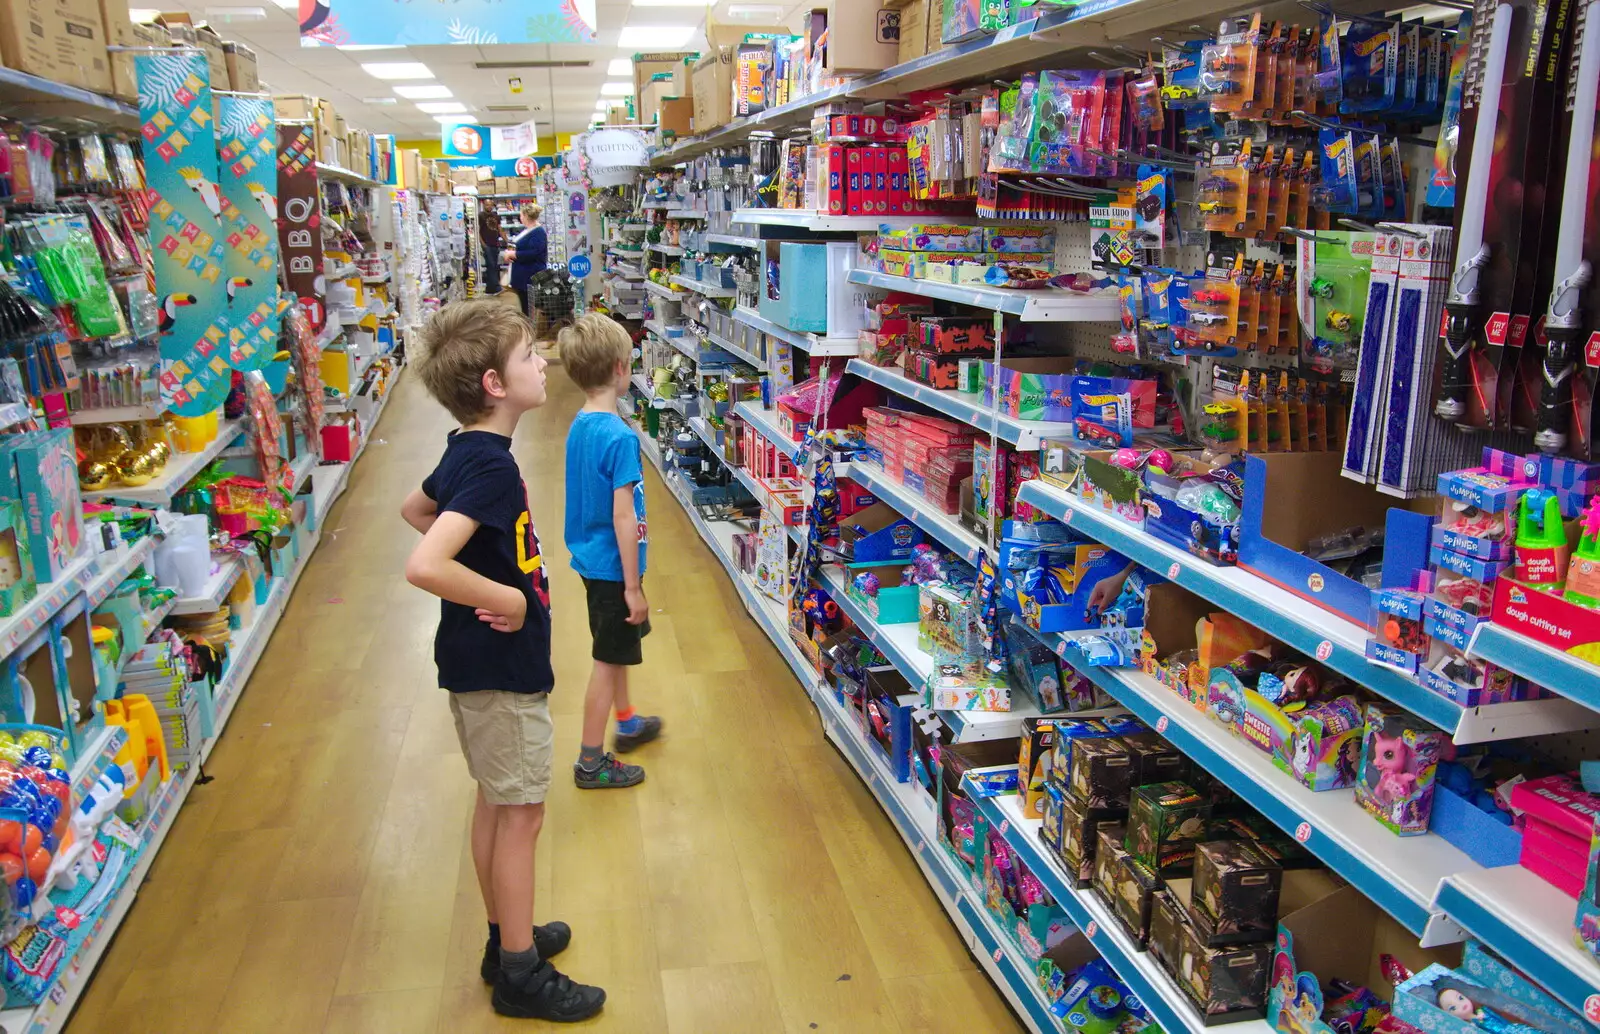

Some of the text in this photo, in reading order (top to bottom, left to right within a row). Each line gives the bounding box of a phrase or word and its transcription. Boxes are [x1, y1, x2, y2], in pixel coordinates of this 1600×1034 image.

[1525, 48, 1537, 77] LIGHT
[1532, 29, 1540, 44] UP
[1546, 52, 1557, 81] LIGHT
[1552, 34, 1560, 48] UP
[591, 143, 639, 153] LIGHTING
[518, 162, 535, 177] £1
[1091, 208, 1130, 217] DUEL LUDO
[285, 197, 314, 273] BBQ
[571, 261, 589, 274] NEW!
[1493, 321, 1506, 330] TRY
[1513, 323, 1526, 331] TRY
[1491, 328, 1502, 337] ME
[1527, 557, 1550, 568] dough
[1528, 566, 1554, 574] cutting
[1506, 606, 1572, 639] dough cutting set
[1243, 712, 1271, 736] SWEETIE
[1243, 722, 1270, 748] FRIENDS
